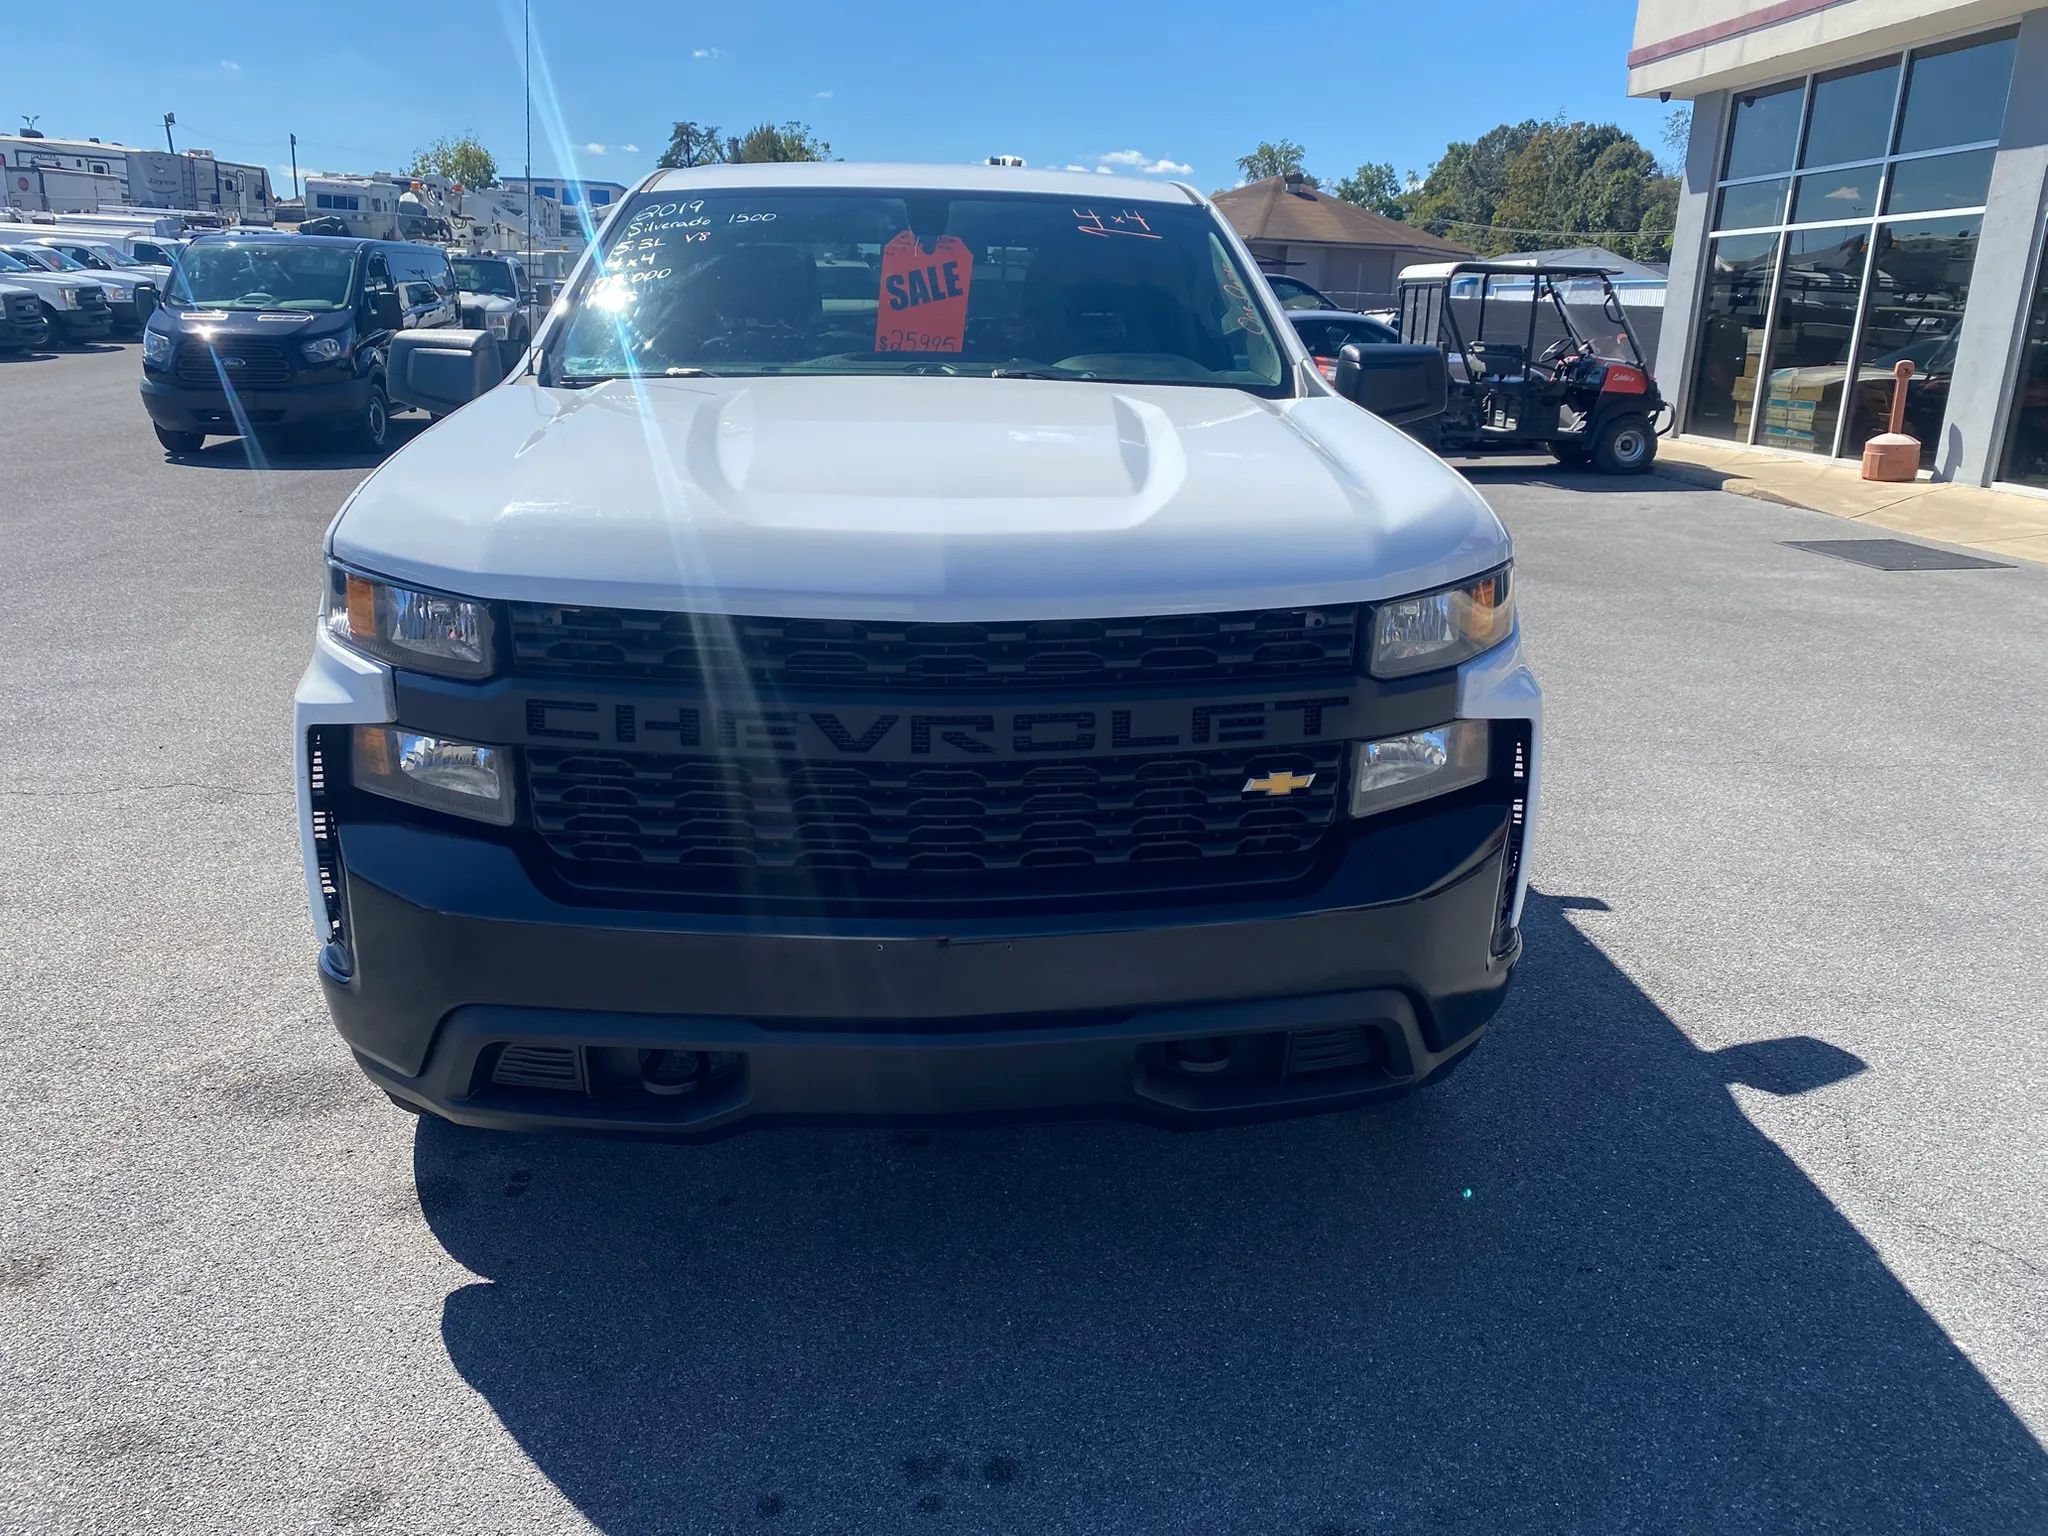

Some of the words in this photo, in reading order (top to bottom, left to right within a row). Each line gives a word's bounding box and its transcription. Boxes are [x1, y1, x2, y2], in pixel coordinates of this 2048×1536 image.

[636, 199, 705, 221] 2019
[627, 217, 712, 237] Silverado
[728, 212, 777, 224] 1500
[685, 231, 711, 243] V8
[885, 261, 964, 312] SALE
[526, 696, 1350, 754] CHEVROLET
